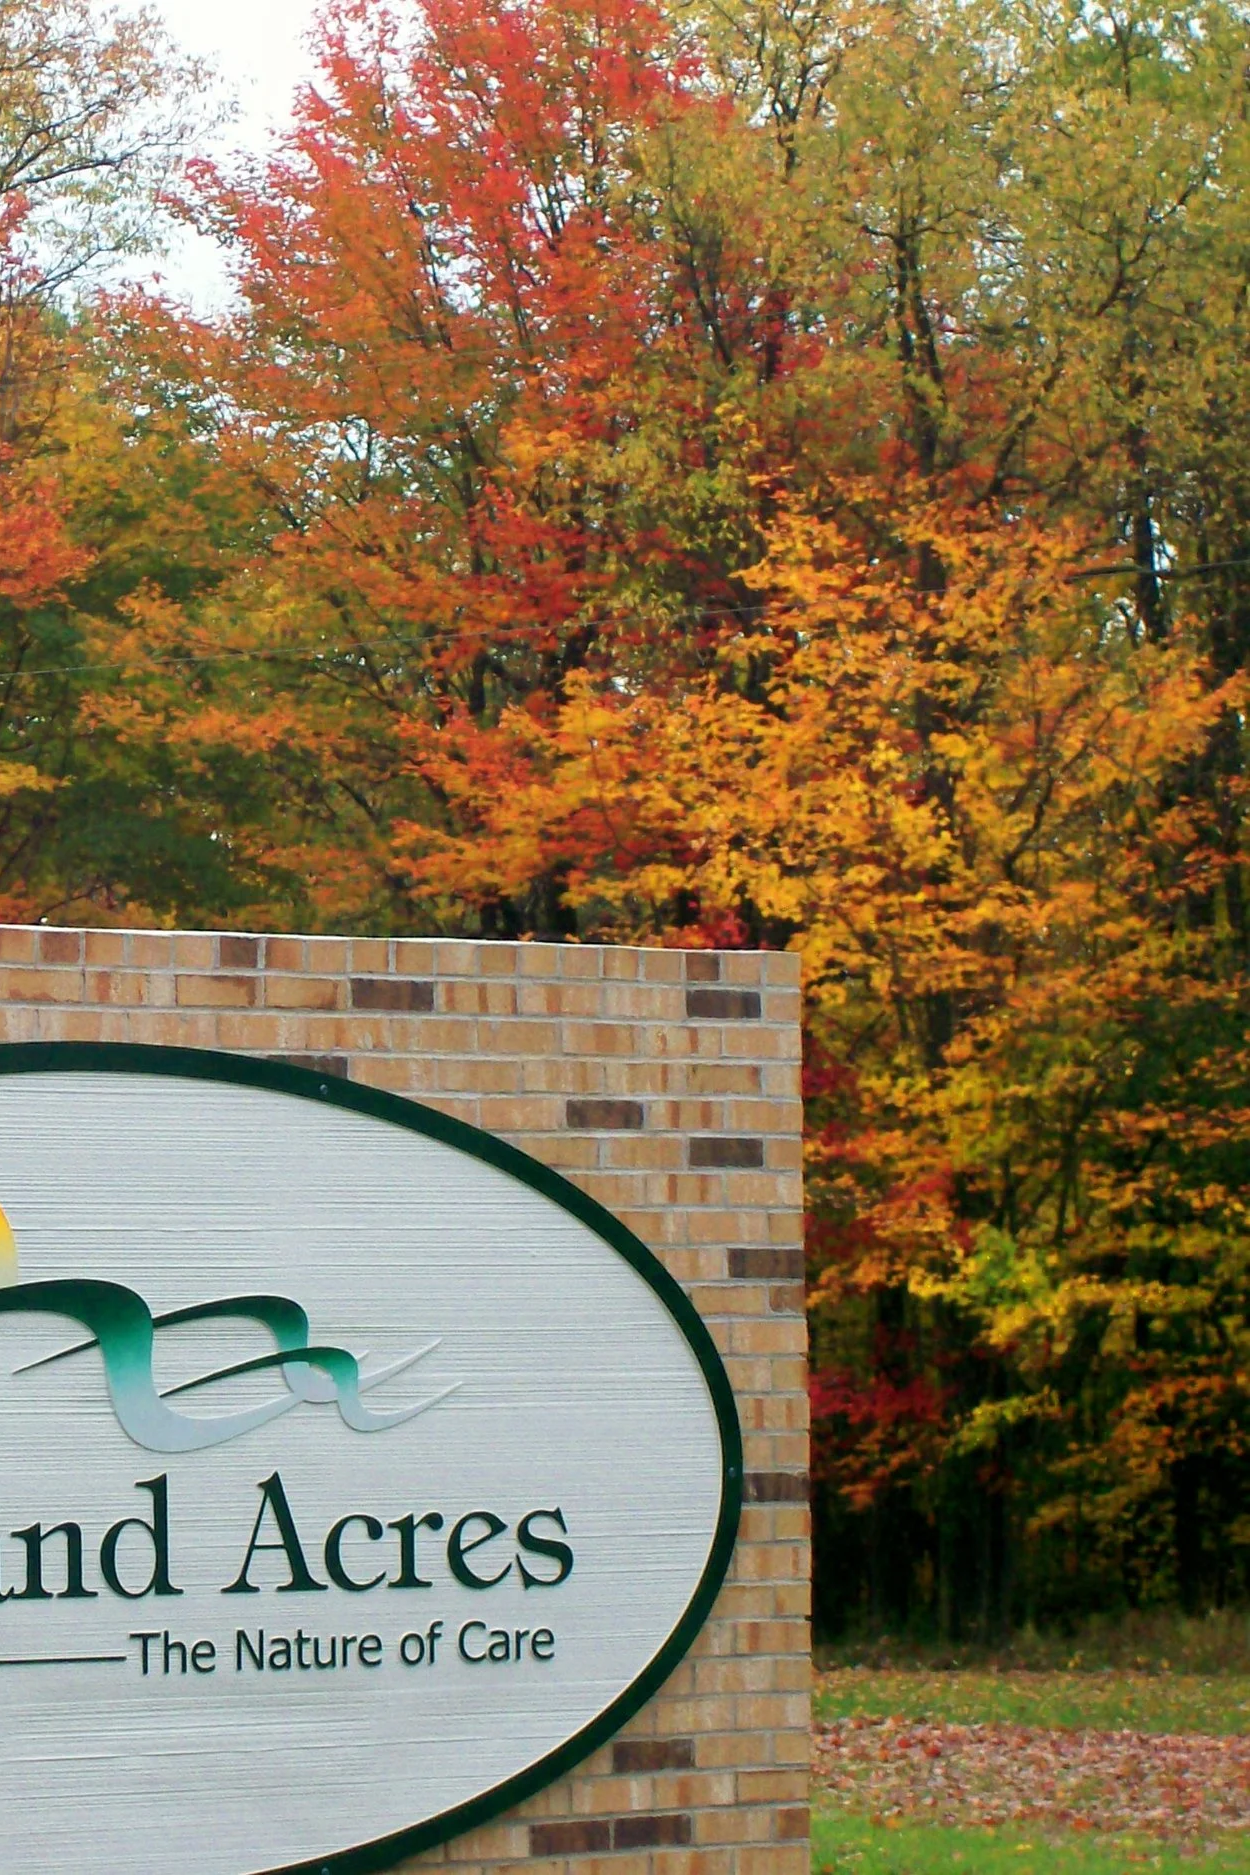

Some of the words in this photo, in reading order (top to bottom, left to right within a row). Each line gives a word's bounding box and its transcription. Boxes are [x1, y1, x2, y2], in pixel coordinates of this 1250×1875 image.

[220, 1471, 575, 1595] Acres
[128, 1630, 217, 1676] The
[235, 1627, 383, 1673] Nature
[399, 1619, 445, 1667] of
[457, 1619, 556, 1664] Care
